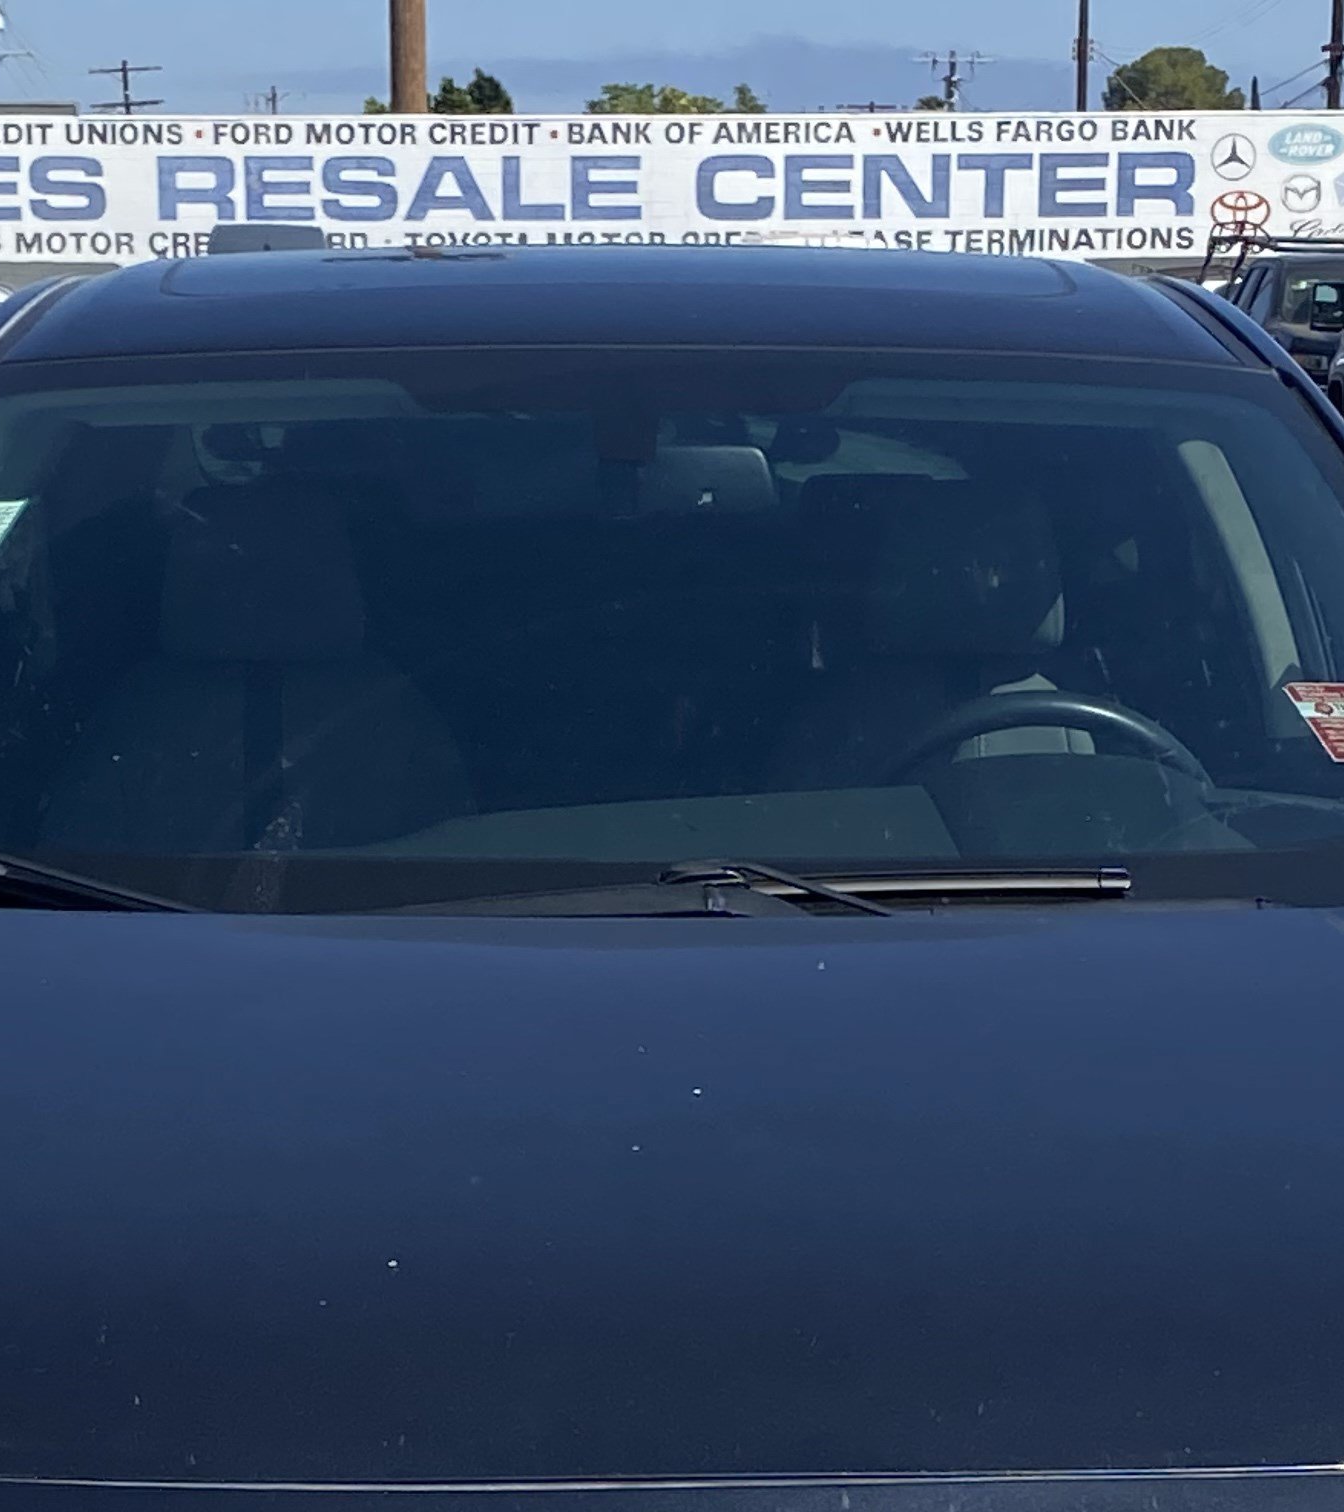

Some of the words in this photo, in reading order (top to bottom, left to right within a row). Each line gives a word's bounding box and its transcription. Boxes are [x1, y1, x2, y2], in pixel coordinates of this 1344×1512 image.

[65, 122, 183, 146] UNIONS
[212, 123, 293, 146] FORD
[305, 123, 417, 146] MOTOR
[428, 123, 541, 146] CREDIT
[566, 122, 652, 145] BANK
[664, 122, 704, 145] OF
[712, 121, 856, 145] AMERICA
[884, 121, 984, 144] WELLS
[995, 120, 1099, 143] FARGO
[1110, 118, 1198, 142] BANK
[156, 155, 643, 221] RESALE
[695, 152, 1196, 221] CENTER
[15, 231, 135, 255] MOTOR
[944, 227, 1195, 256] TERMINATIONS
